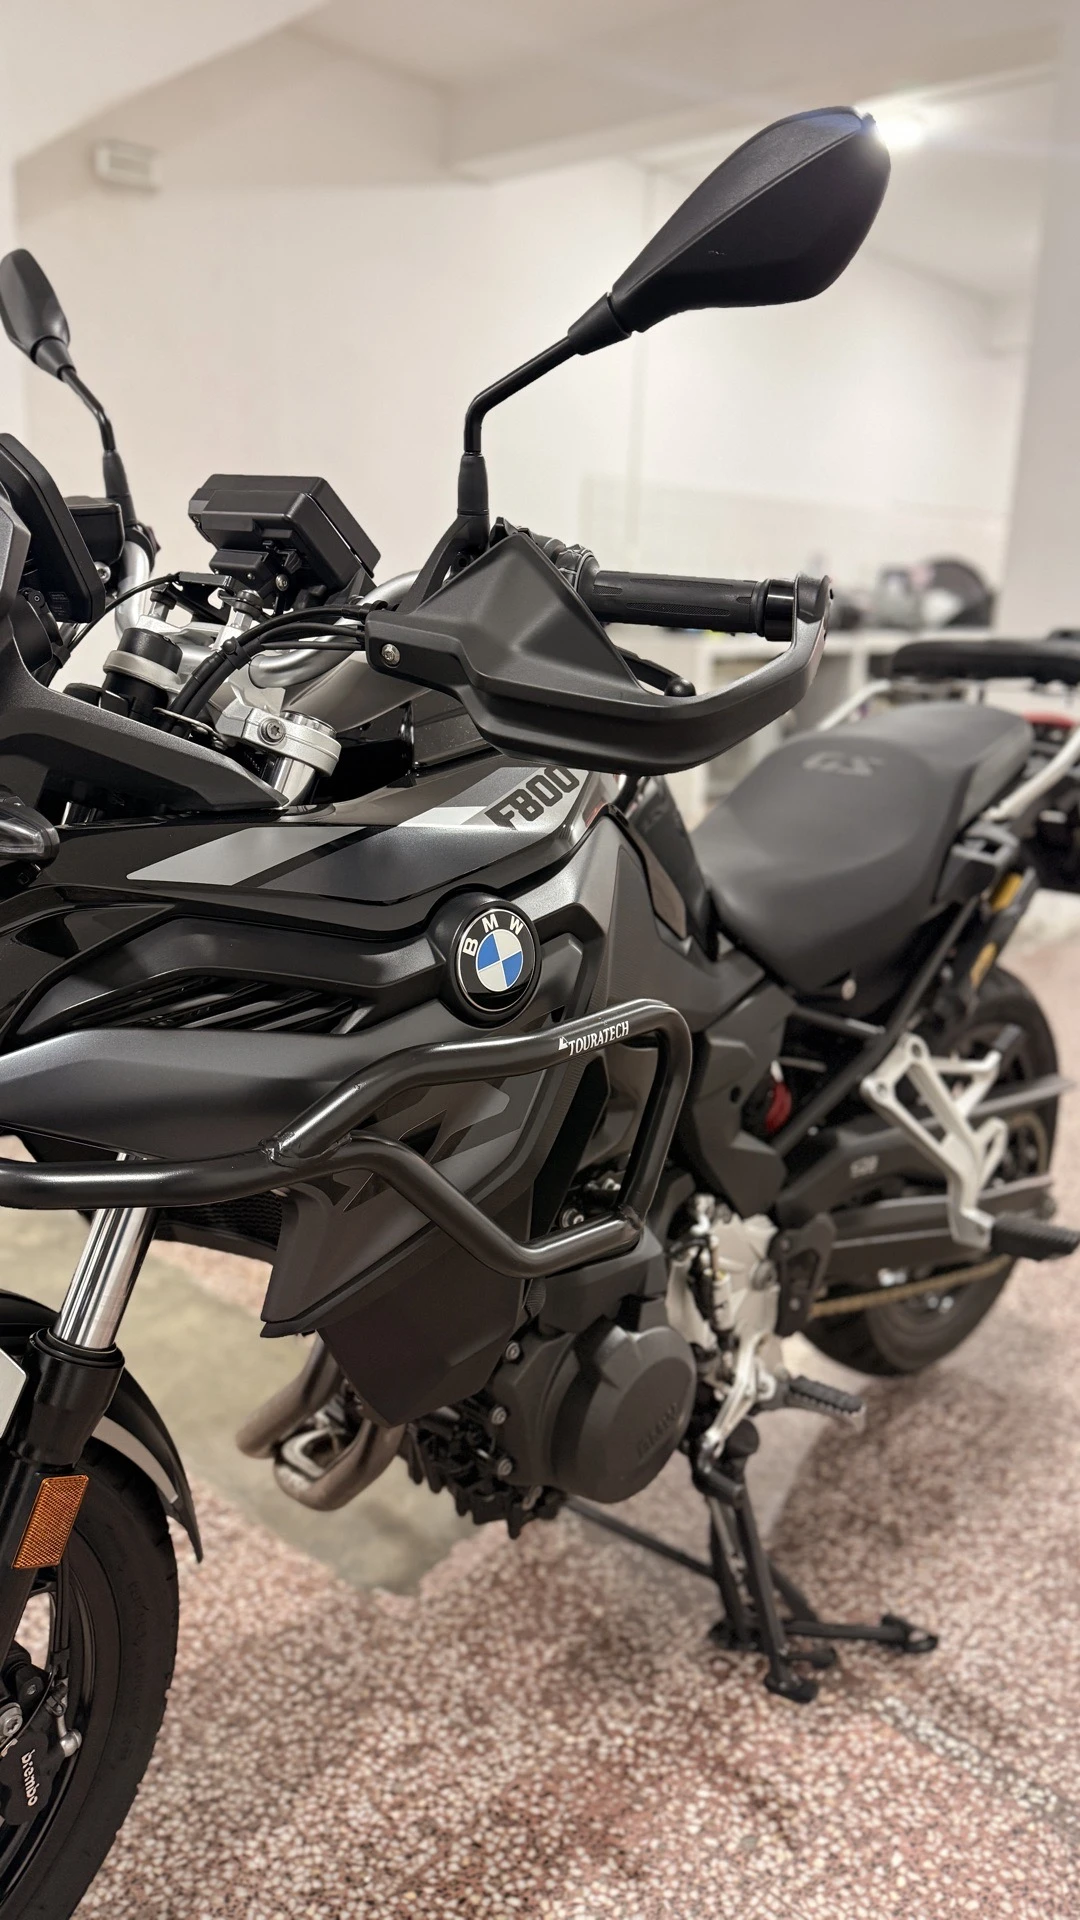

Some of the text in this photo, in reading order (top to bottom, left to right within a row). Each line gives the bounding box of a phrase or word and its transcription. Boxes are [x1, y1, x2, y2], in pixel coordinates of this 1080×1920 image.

[484, 766, 580, 831] F800
[463, 914, 523, 956] BMW
[568, 1021, 629, 1056] TOURATECH
[21, 1749, 40, 1806] brembo
